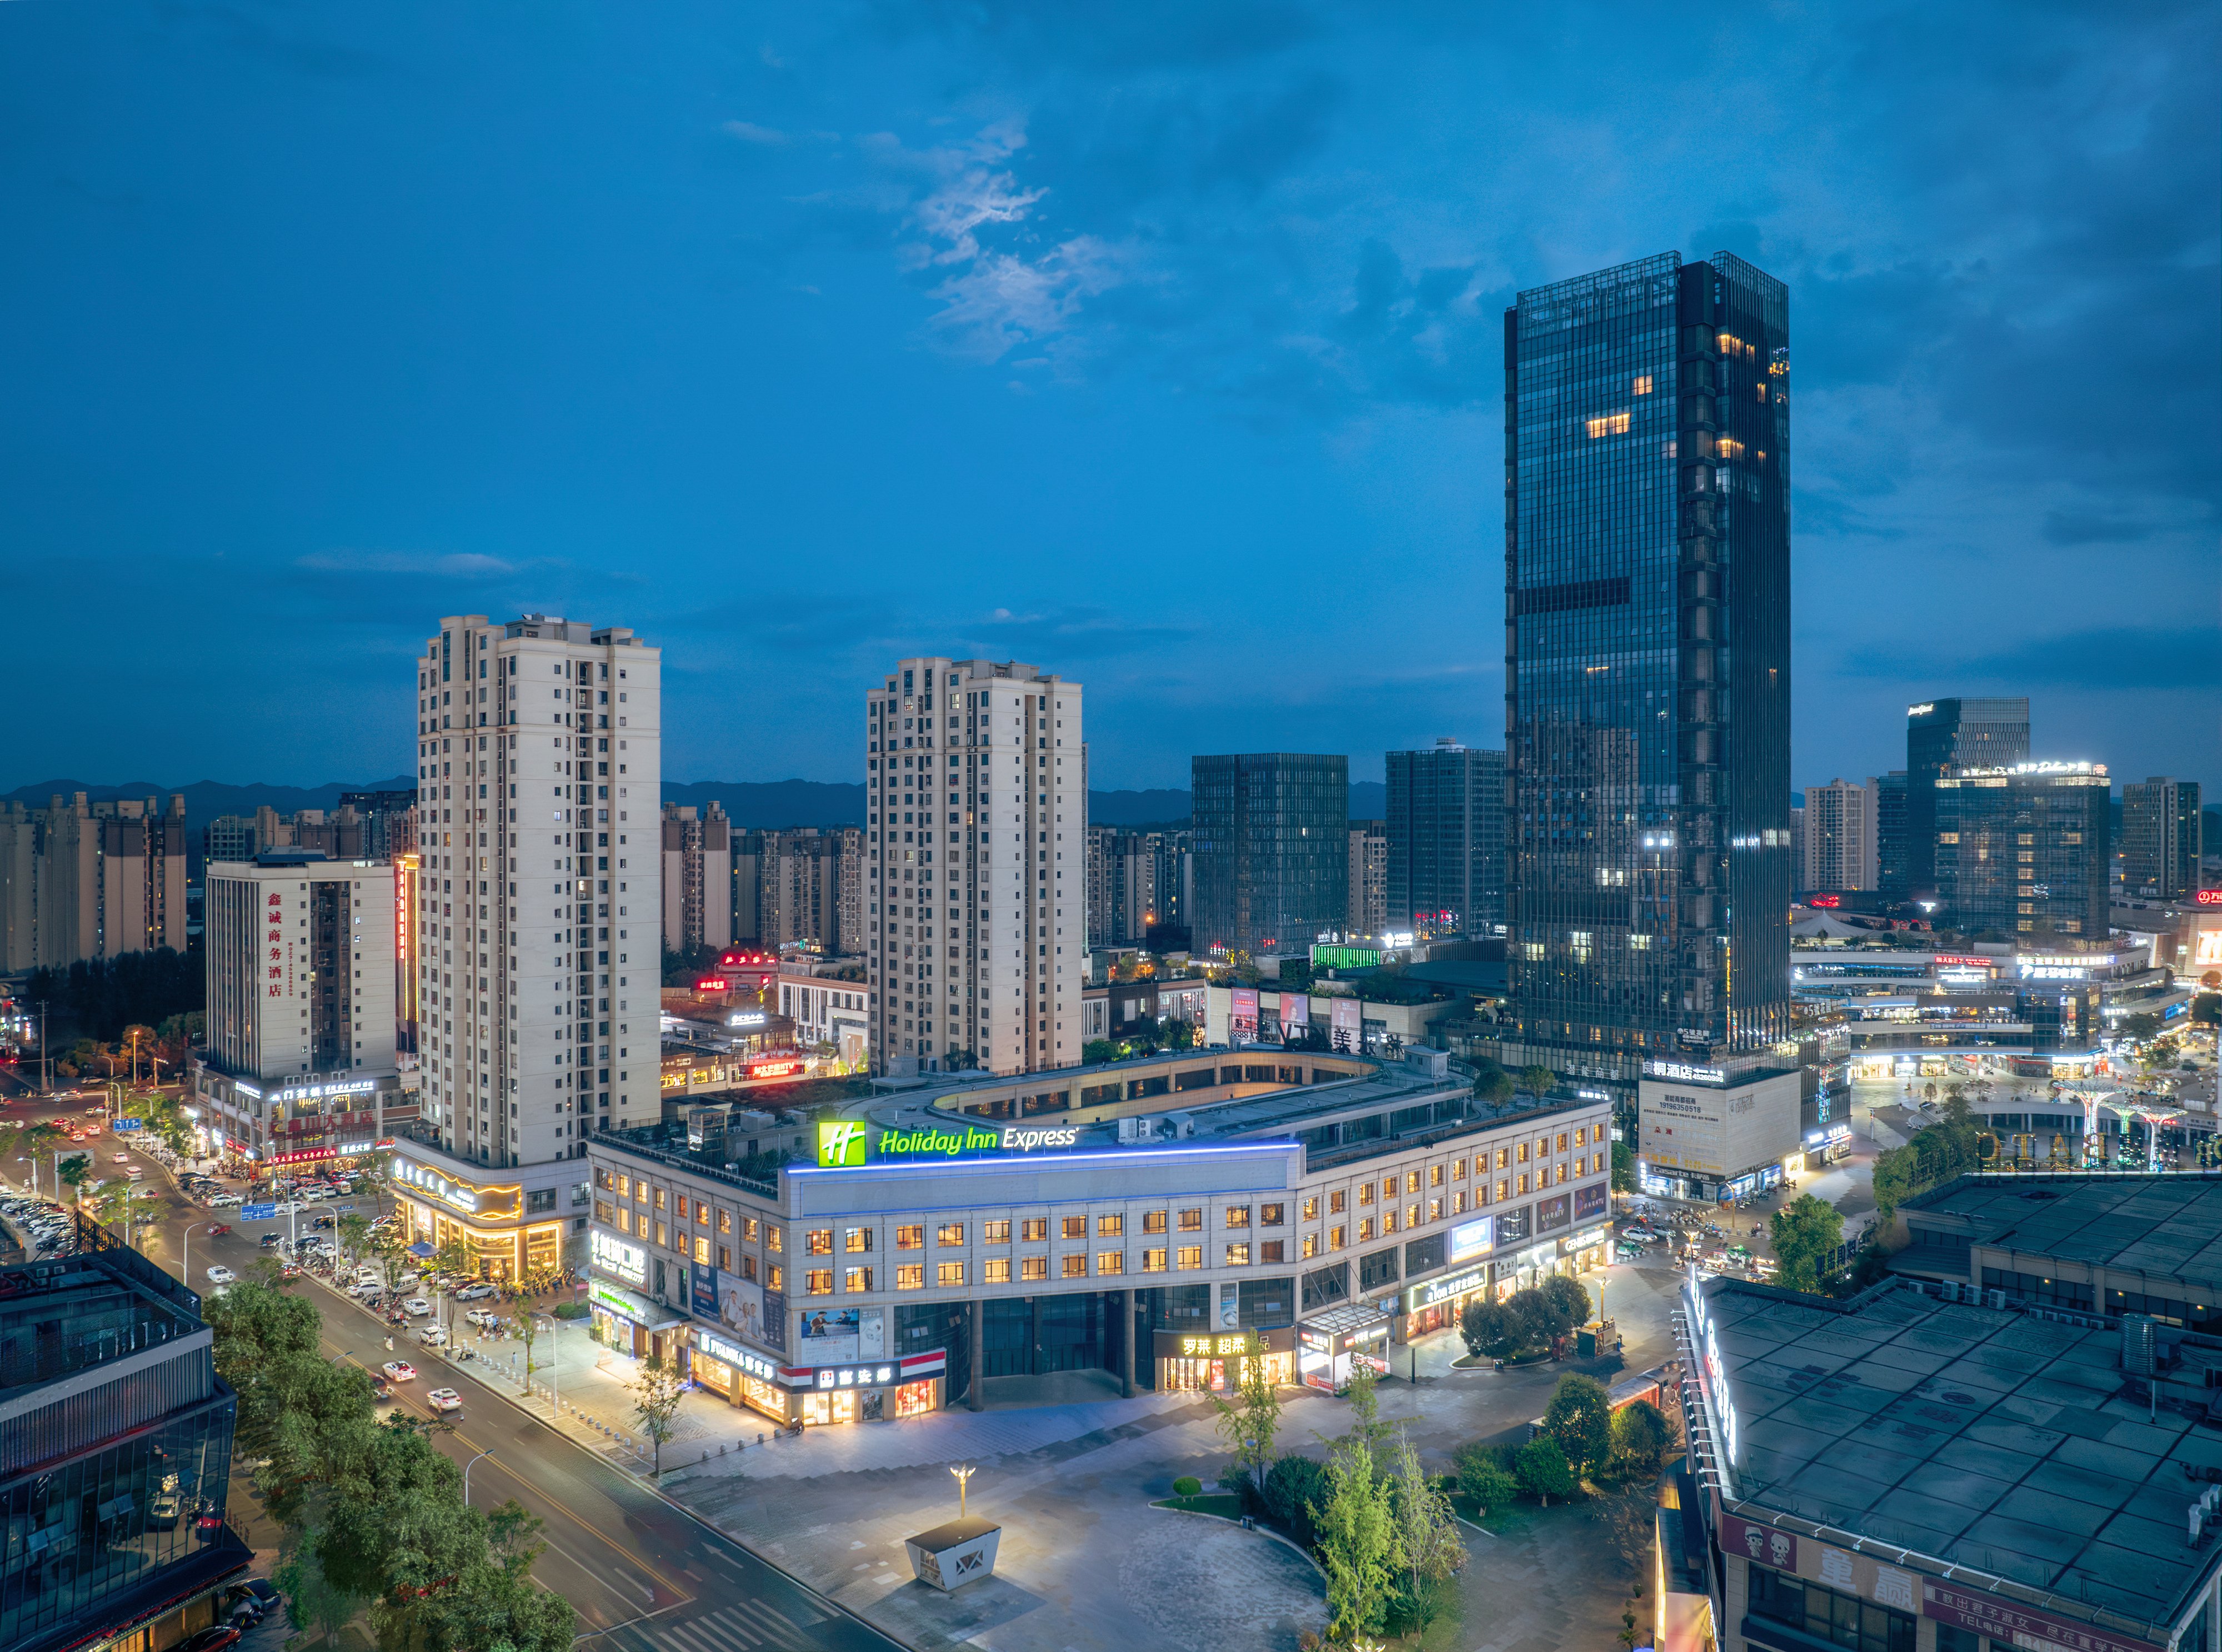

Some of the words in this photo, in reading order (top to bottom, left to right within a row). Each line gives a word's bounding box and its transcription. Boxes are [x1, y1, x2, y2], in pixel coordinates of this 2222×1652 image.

[268, 893, 282, 997] 鑫诚商务酒店
[1567, 1064, 1619, 1080] 潜能商都
[1642, 1061, 1693, 1079] 良桐酒店
[1692, 1073, 1724, 1083] 45260999
[1659, 1102, 1701, 1113] 19196350518
[1664, 1094, 1696, 1105] 潜能商都招商
[879, 1130, 962, 1155] Holiday
[966, 1127, 997, 1149] Inn
[1002, 1127, 1078, 1152] Express
[1653, 1167, 1689, 1178] Casarte
[1691, 1172, 1710, 1181] 卡萨帝
[1183, 1338, 1211, 1355] 罗莱
[839, 1367, 891, 1386] 富安娜
[1818, 1548, 1917, 1610] 童赢
[1943, 1592, 2029, 1630] 教出君子淑女
